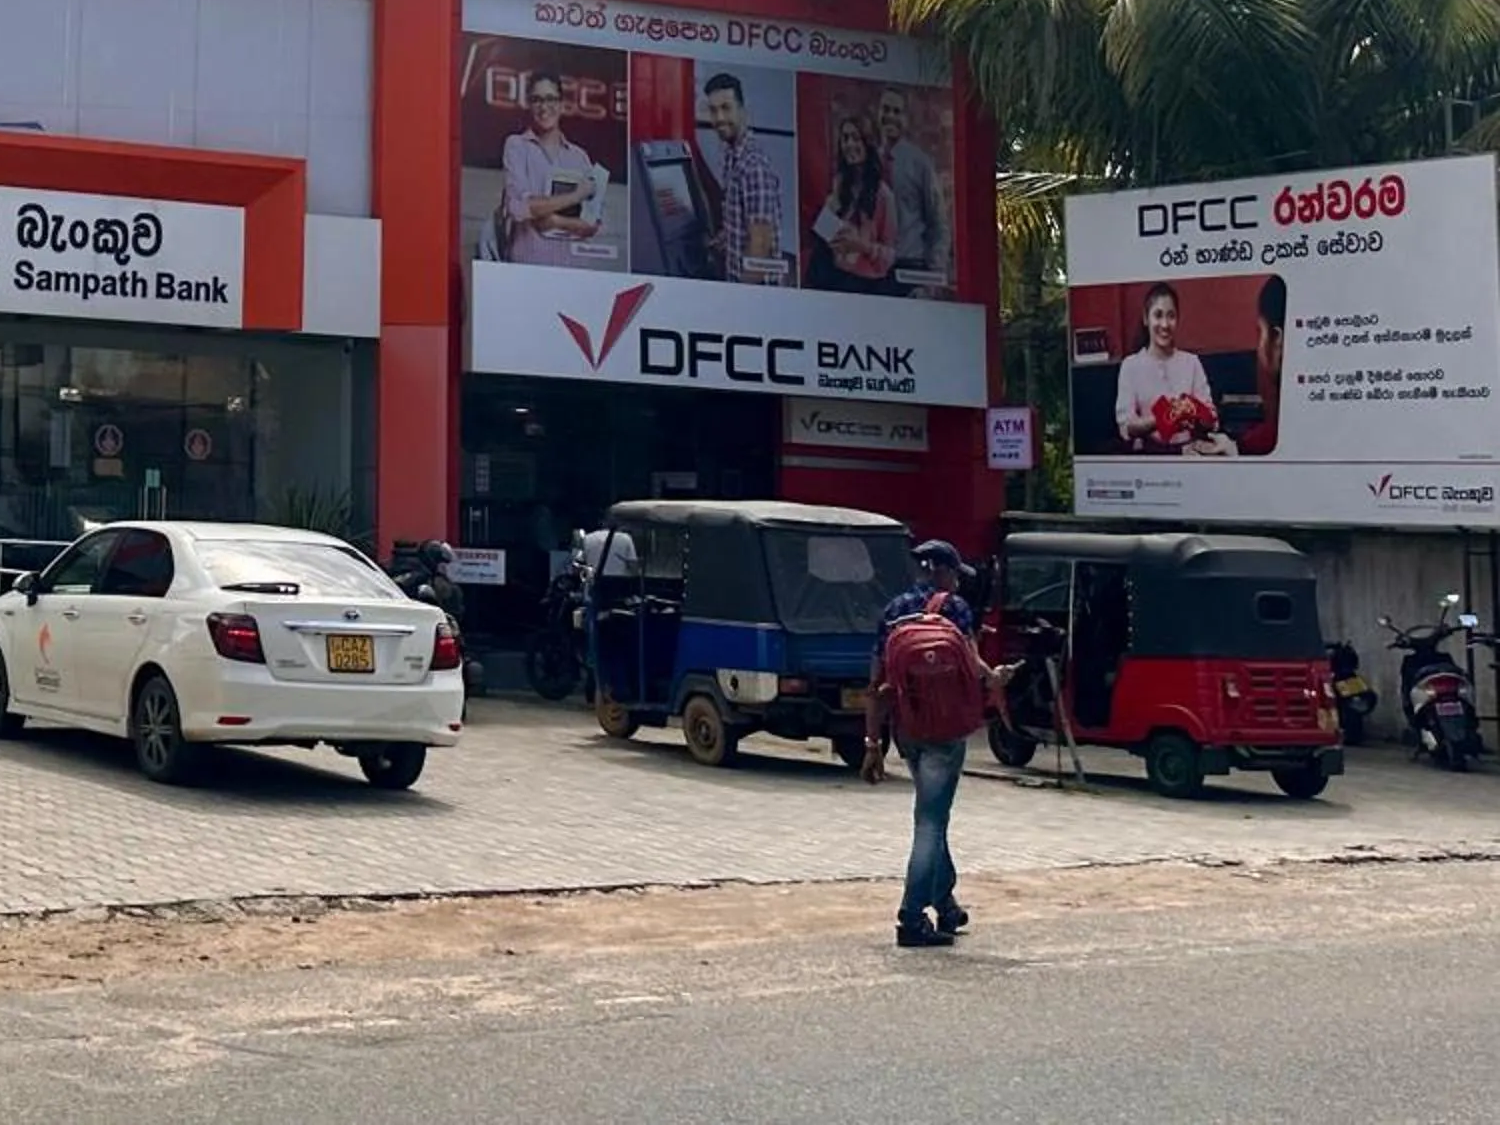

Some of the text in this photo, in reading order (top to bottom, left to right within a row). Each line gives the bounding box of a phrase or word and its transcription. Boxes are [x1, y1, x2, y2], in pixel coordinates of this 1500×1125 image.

[535, 2, 607, 29] කාටත්
[728, 21, 802, 52] DFCC
[809, 32, 888, 67] බැංකුව
[1138, 174, 1405, 237] DFCC රන්වරම
[17, 203, 163, 266] බැංකුව
[1159, 230, 1383, 267] රන් භාණ්ඩ උකස් සේවාව
[13, 260, 148, 300] Sampath
[155, 272, 229, 304] Bank
[640, 328, 916, 386] DFCC BANK
[993, 419, 1025, 434] ATM
[1389, 486, 1439, 500] DFCC
